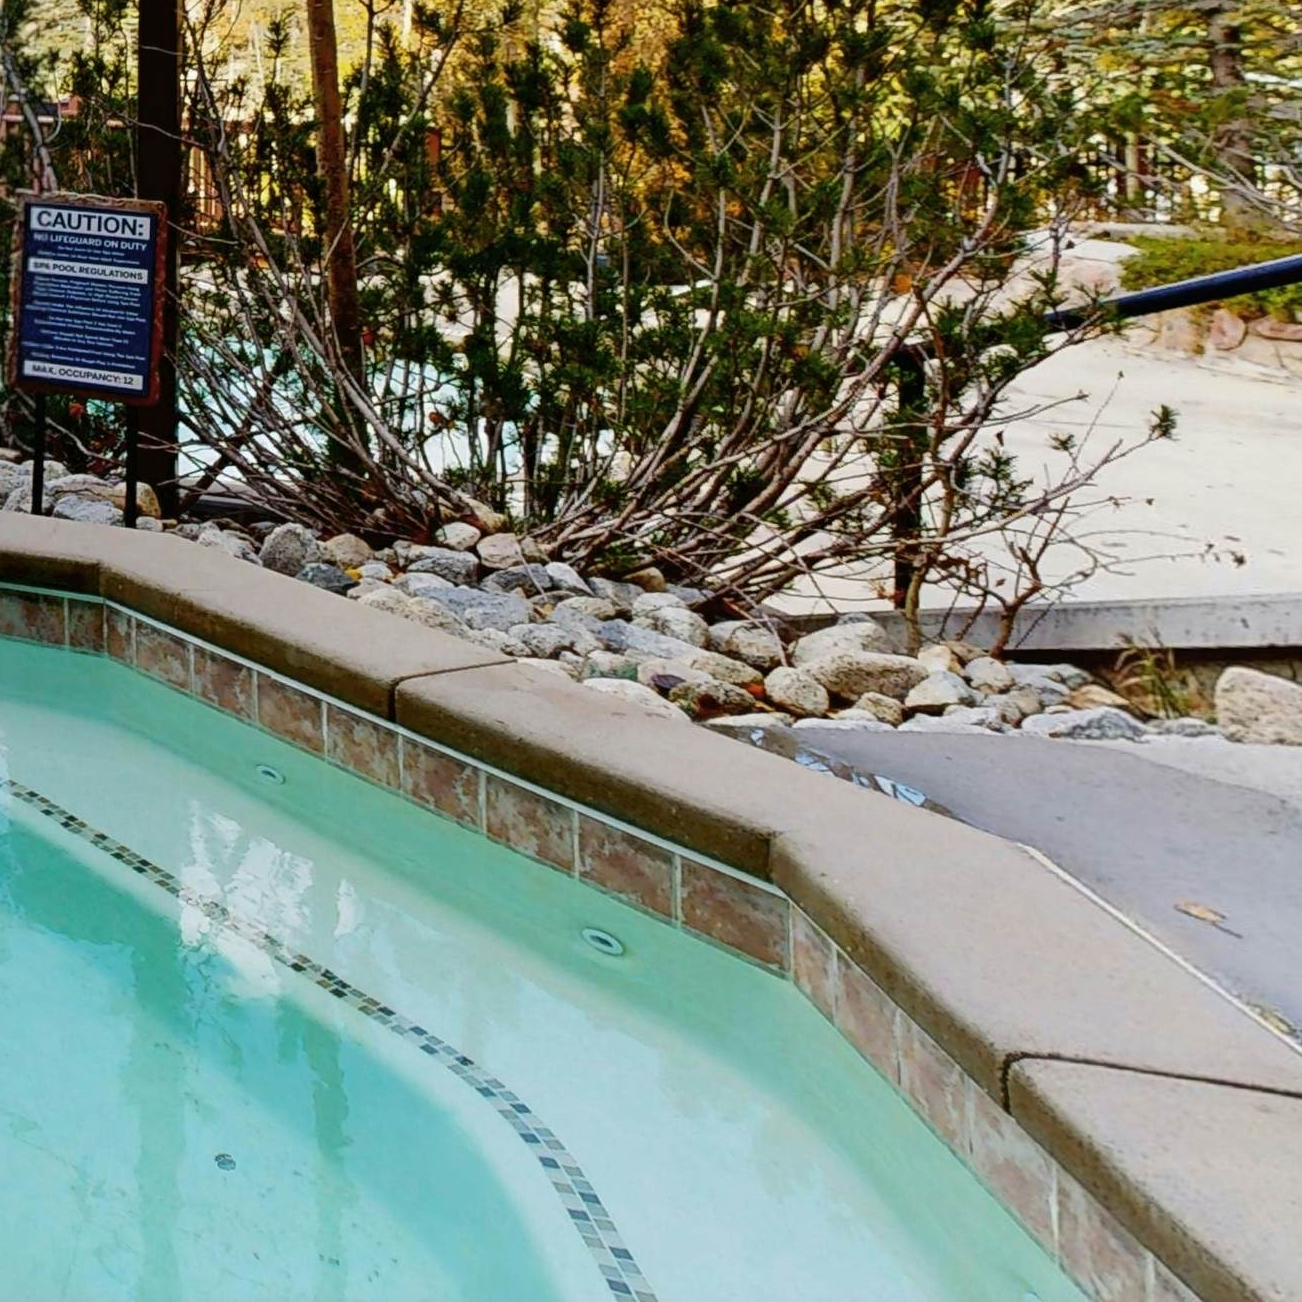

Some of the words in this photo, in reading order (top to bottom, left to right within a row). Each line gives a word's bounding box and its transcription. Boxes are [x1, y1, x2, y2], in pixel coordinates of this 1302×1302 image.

[37, 210, 144, 237] CAUTION:
[50, 233, 102, 247] LIFEGUARD
[103, 240, 118, 249] ON
[120, 240, 147, 251] DUTY
[52, 263, 77, 274] POOL
[78, 265, 144, 280] REGULATIONS
[58, 368, 120, 384] OCCUPANCY:
[123, 376, 134, 385] 12
